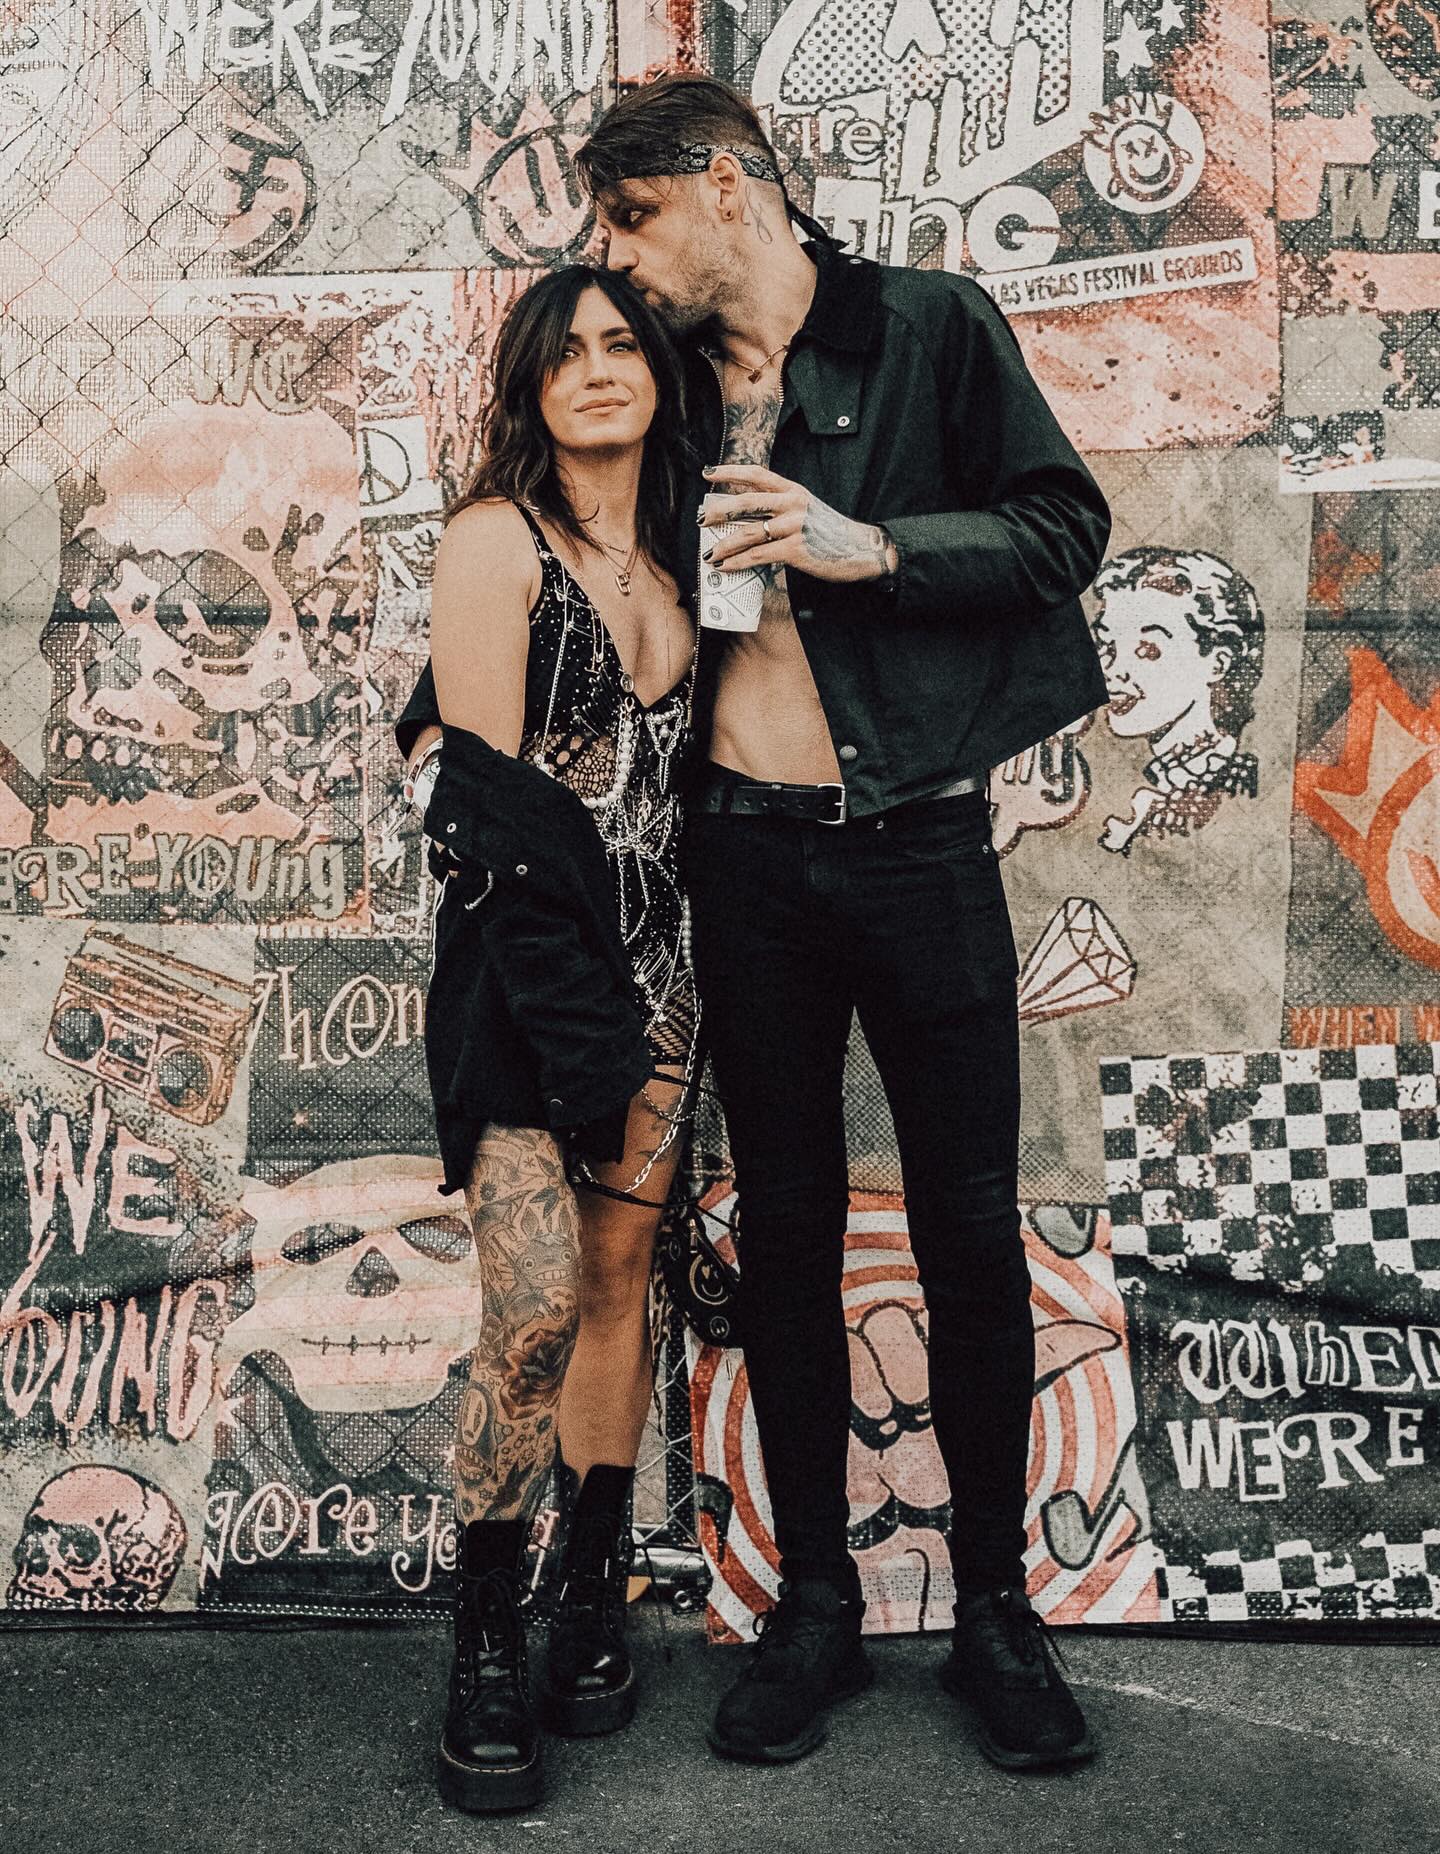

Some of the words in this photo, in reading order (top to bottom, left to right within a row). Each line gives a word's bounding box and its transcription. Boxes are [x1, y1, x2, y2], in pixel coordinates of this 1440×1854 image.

[1025, 271, 1078, 301] VEGAS
[1084, 260, 1159, 294] FESTIVAL
[1164, 248, 1244, 282] GROUNDS
[15, 1084, 184, 1262] WE
[1165, 1405, 1425, 1502] WERE
